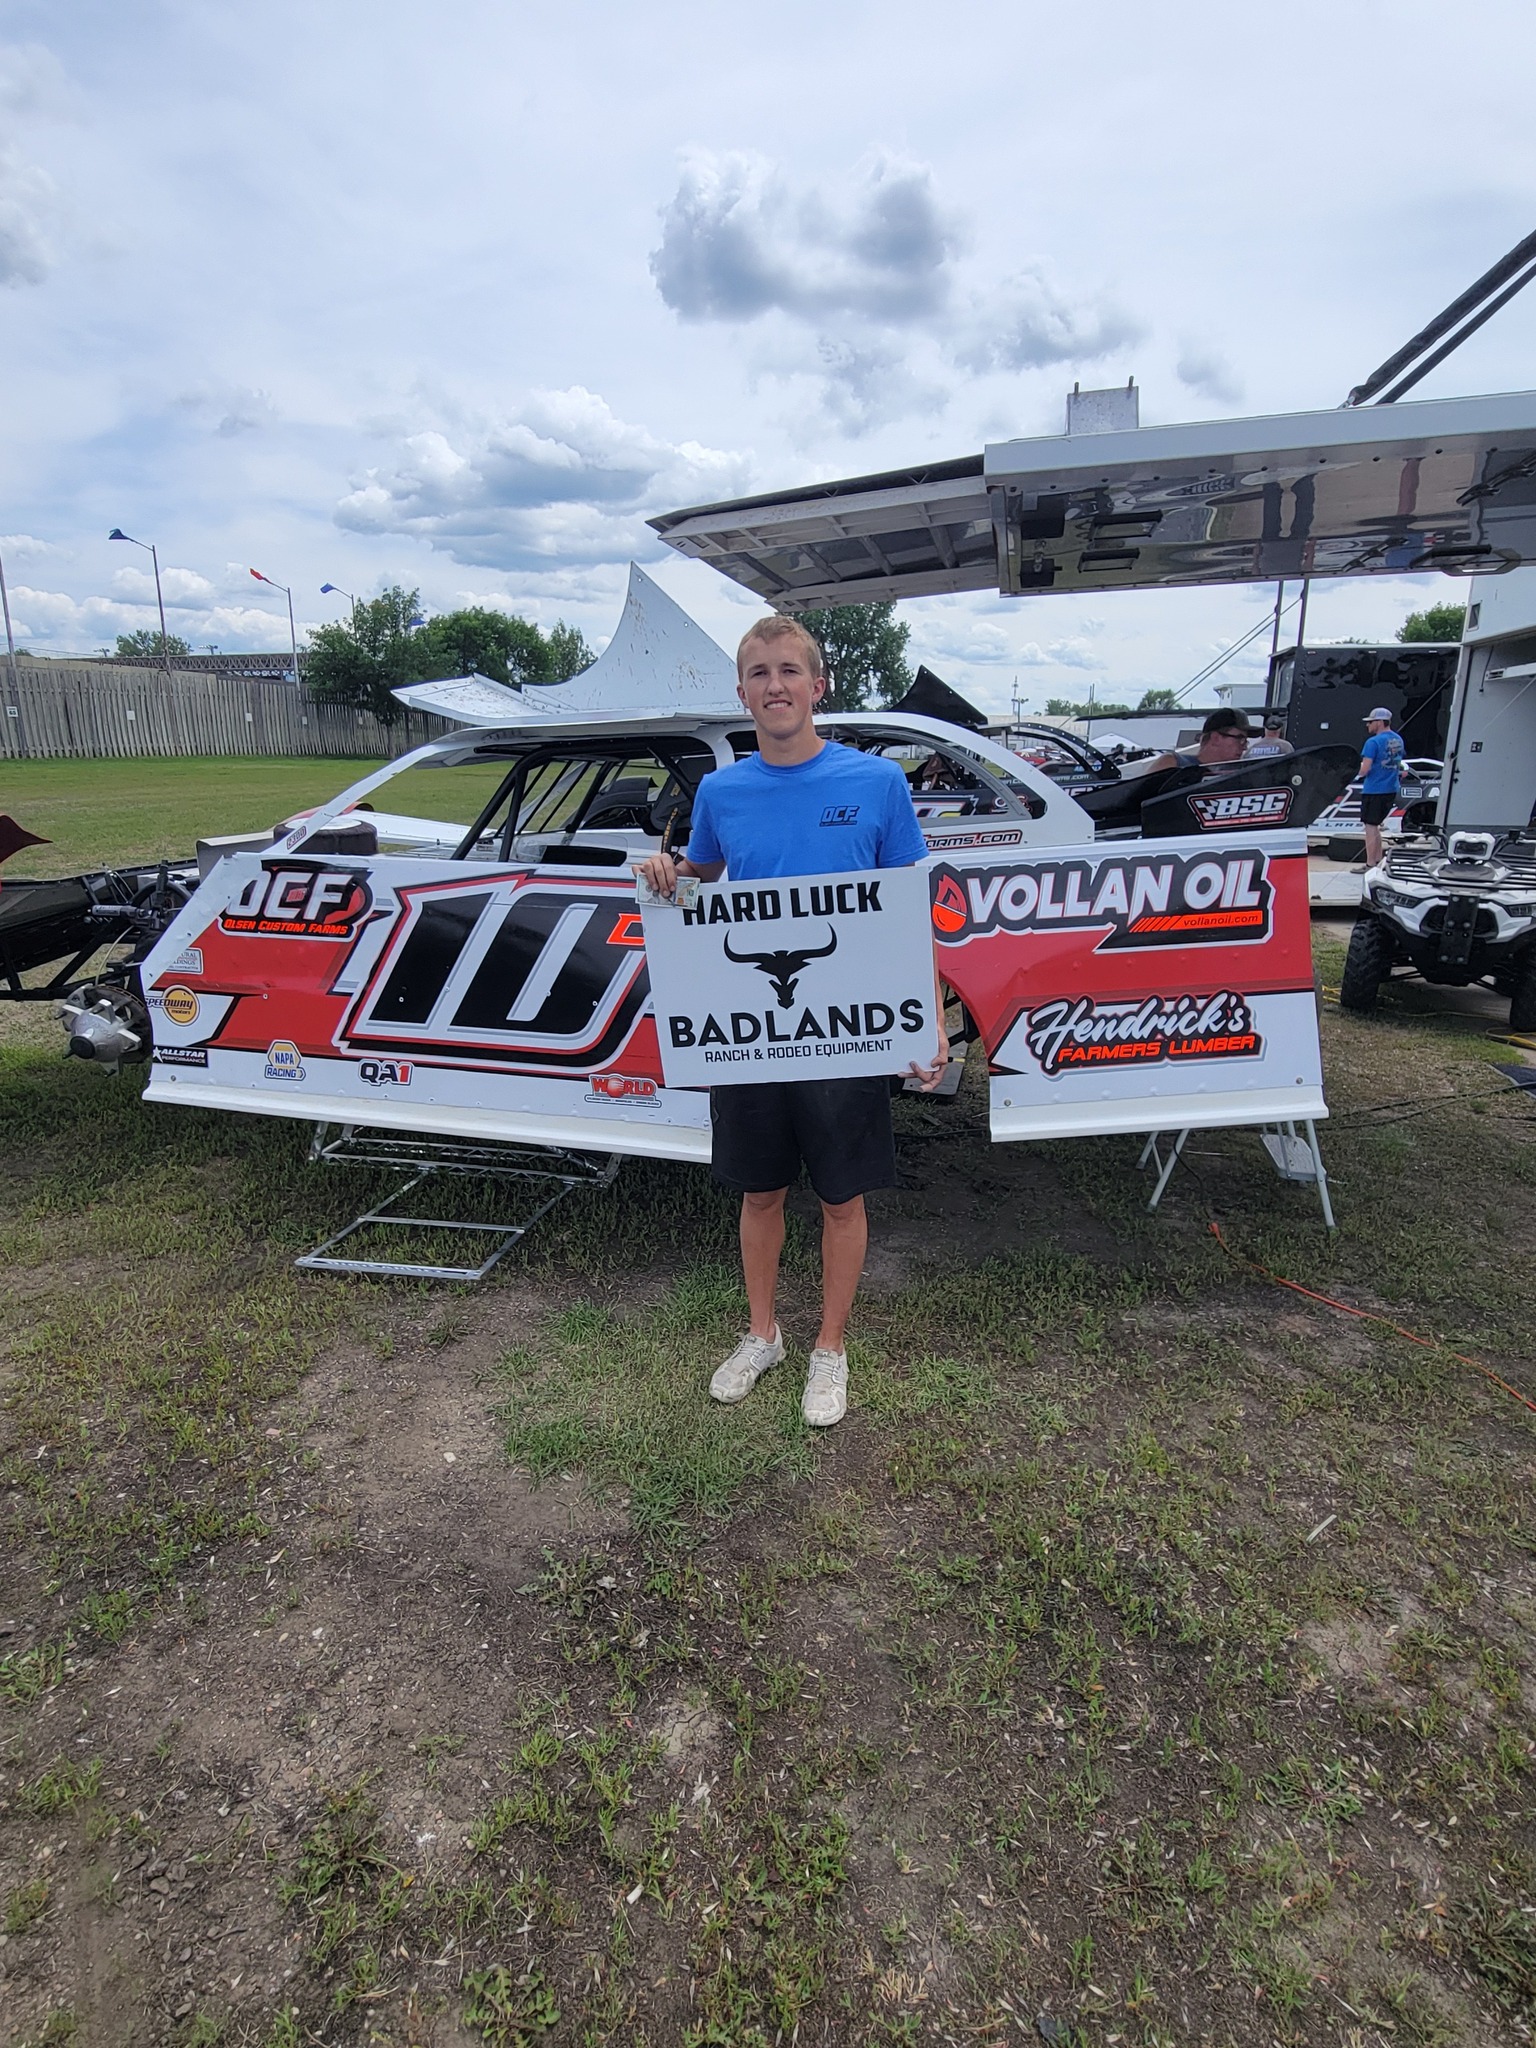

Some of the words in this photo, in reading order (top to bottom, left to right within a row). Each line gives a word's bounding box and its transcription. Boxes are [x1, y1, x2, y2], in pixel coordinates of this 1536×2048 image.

[821, 806, 860, 823] OCF
[1215, 792, 1288, 816] BSG
[924, 833, 1019, 847] arms.com
[225, 871, 353, 920] OCF
[682, 889, 781, 926] HARD
[790, 881, 883, 918] LUCK
[966, 864, 1174, 926] VOLLAN
[1183, 860, 1261, 909] OIL
[223, 918, 257, 931] OLSEN
[258, 920, 307, 933] CUSTOM
[308, 923, 349, 935] FARMS
[1184, 914, 1259, 927] vollanoil.com
[669, 999, 924, 1048] BADLANDS
[1029, 992, 1245, 1069] Hendrick's
[161, 1048, 206, 1058] ALLSTAR
[274, 1052, 295, 1065] NAPA
[704, 1049, 750, 1063] RANCH
[754, 1048, 764, 1060] &
[767, 1045, 812, 1059] RODEO
[815, 1039, 893, 1058] EQUIPMENT
[1057, 1041, 1162, 1062] FARMERS
[1168, 1035, 1256, 1055] LUMBER
[162, 1056, 206, 1064] PERFORMANCE
[266, 1067, 297, 1078] RACING
[360, 1062, 410, 1083] QA1
[592, 1077, 654, 1098] WORLD
